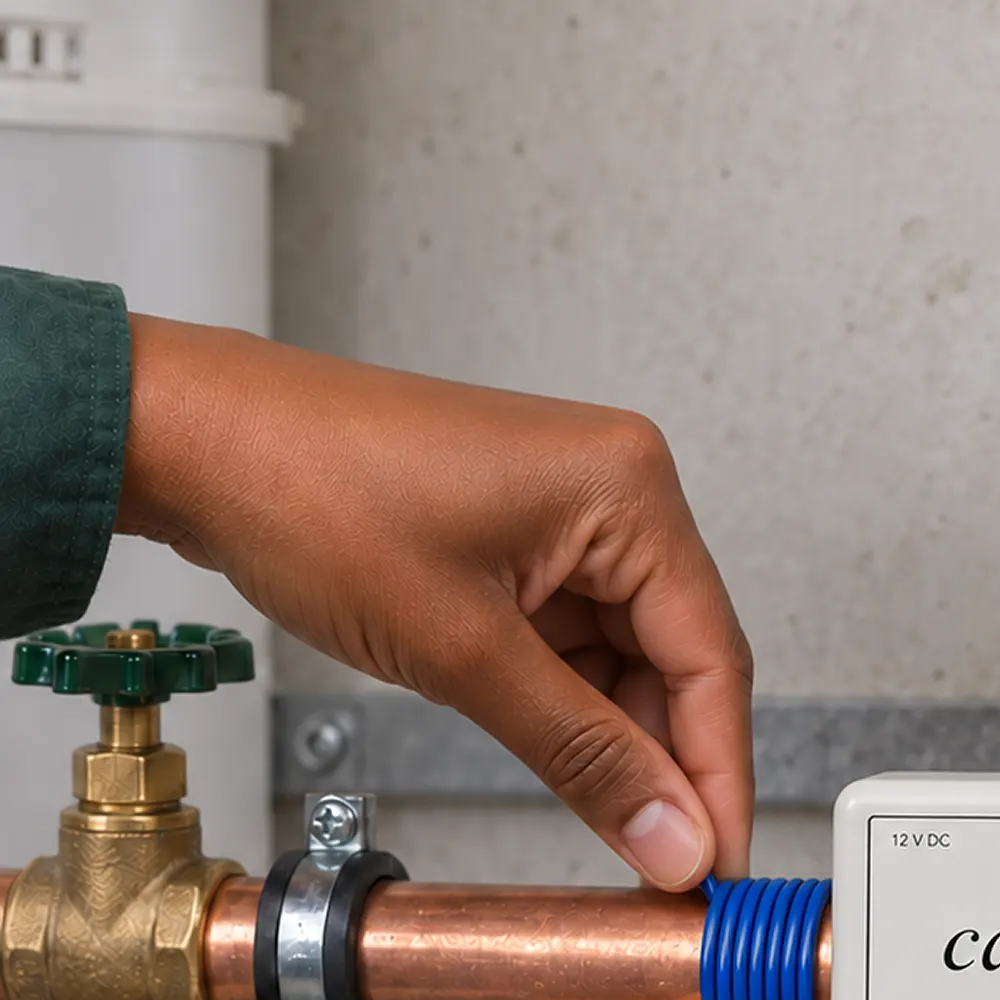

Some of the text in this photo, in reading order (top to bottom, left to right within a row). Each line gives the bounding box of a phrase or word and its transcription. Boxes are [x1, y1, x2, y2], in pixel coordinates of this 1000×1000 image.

[892, 832, 951, 848] 12 V DC
